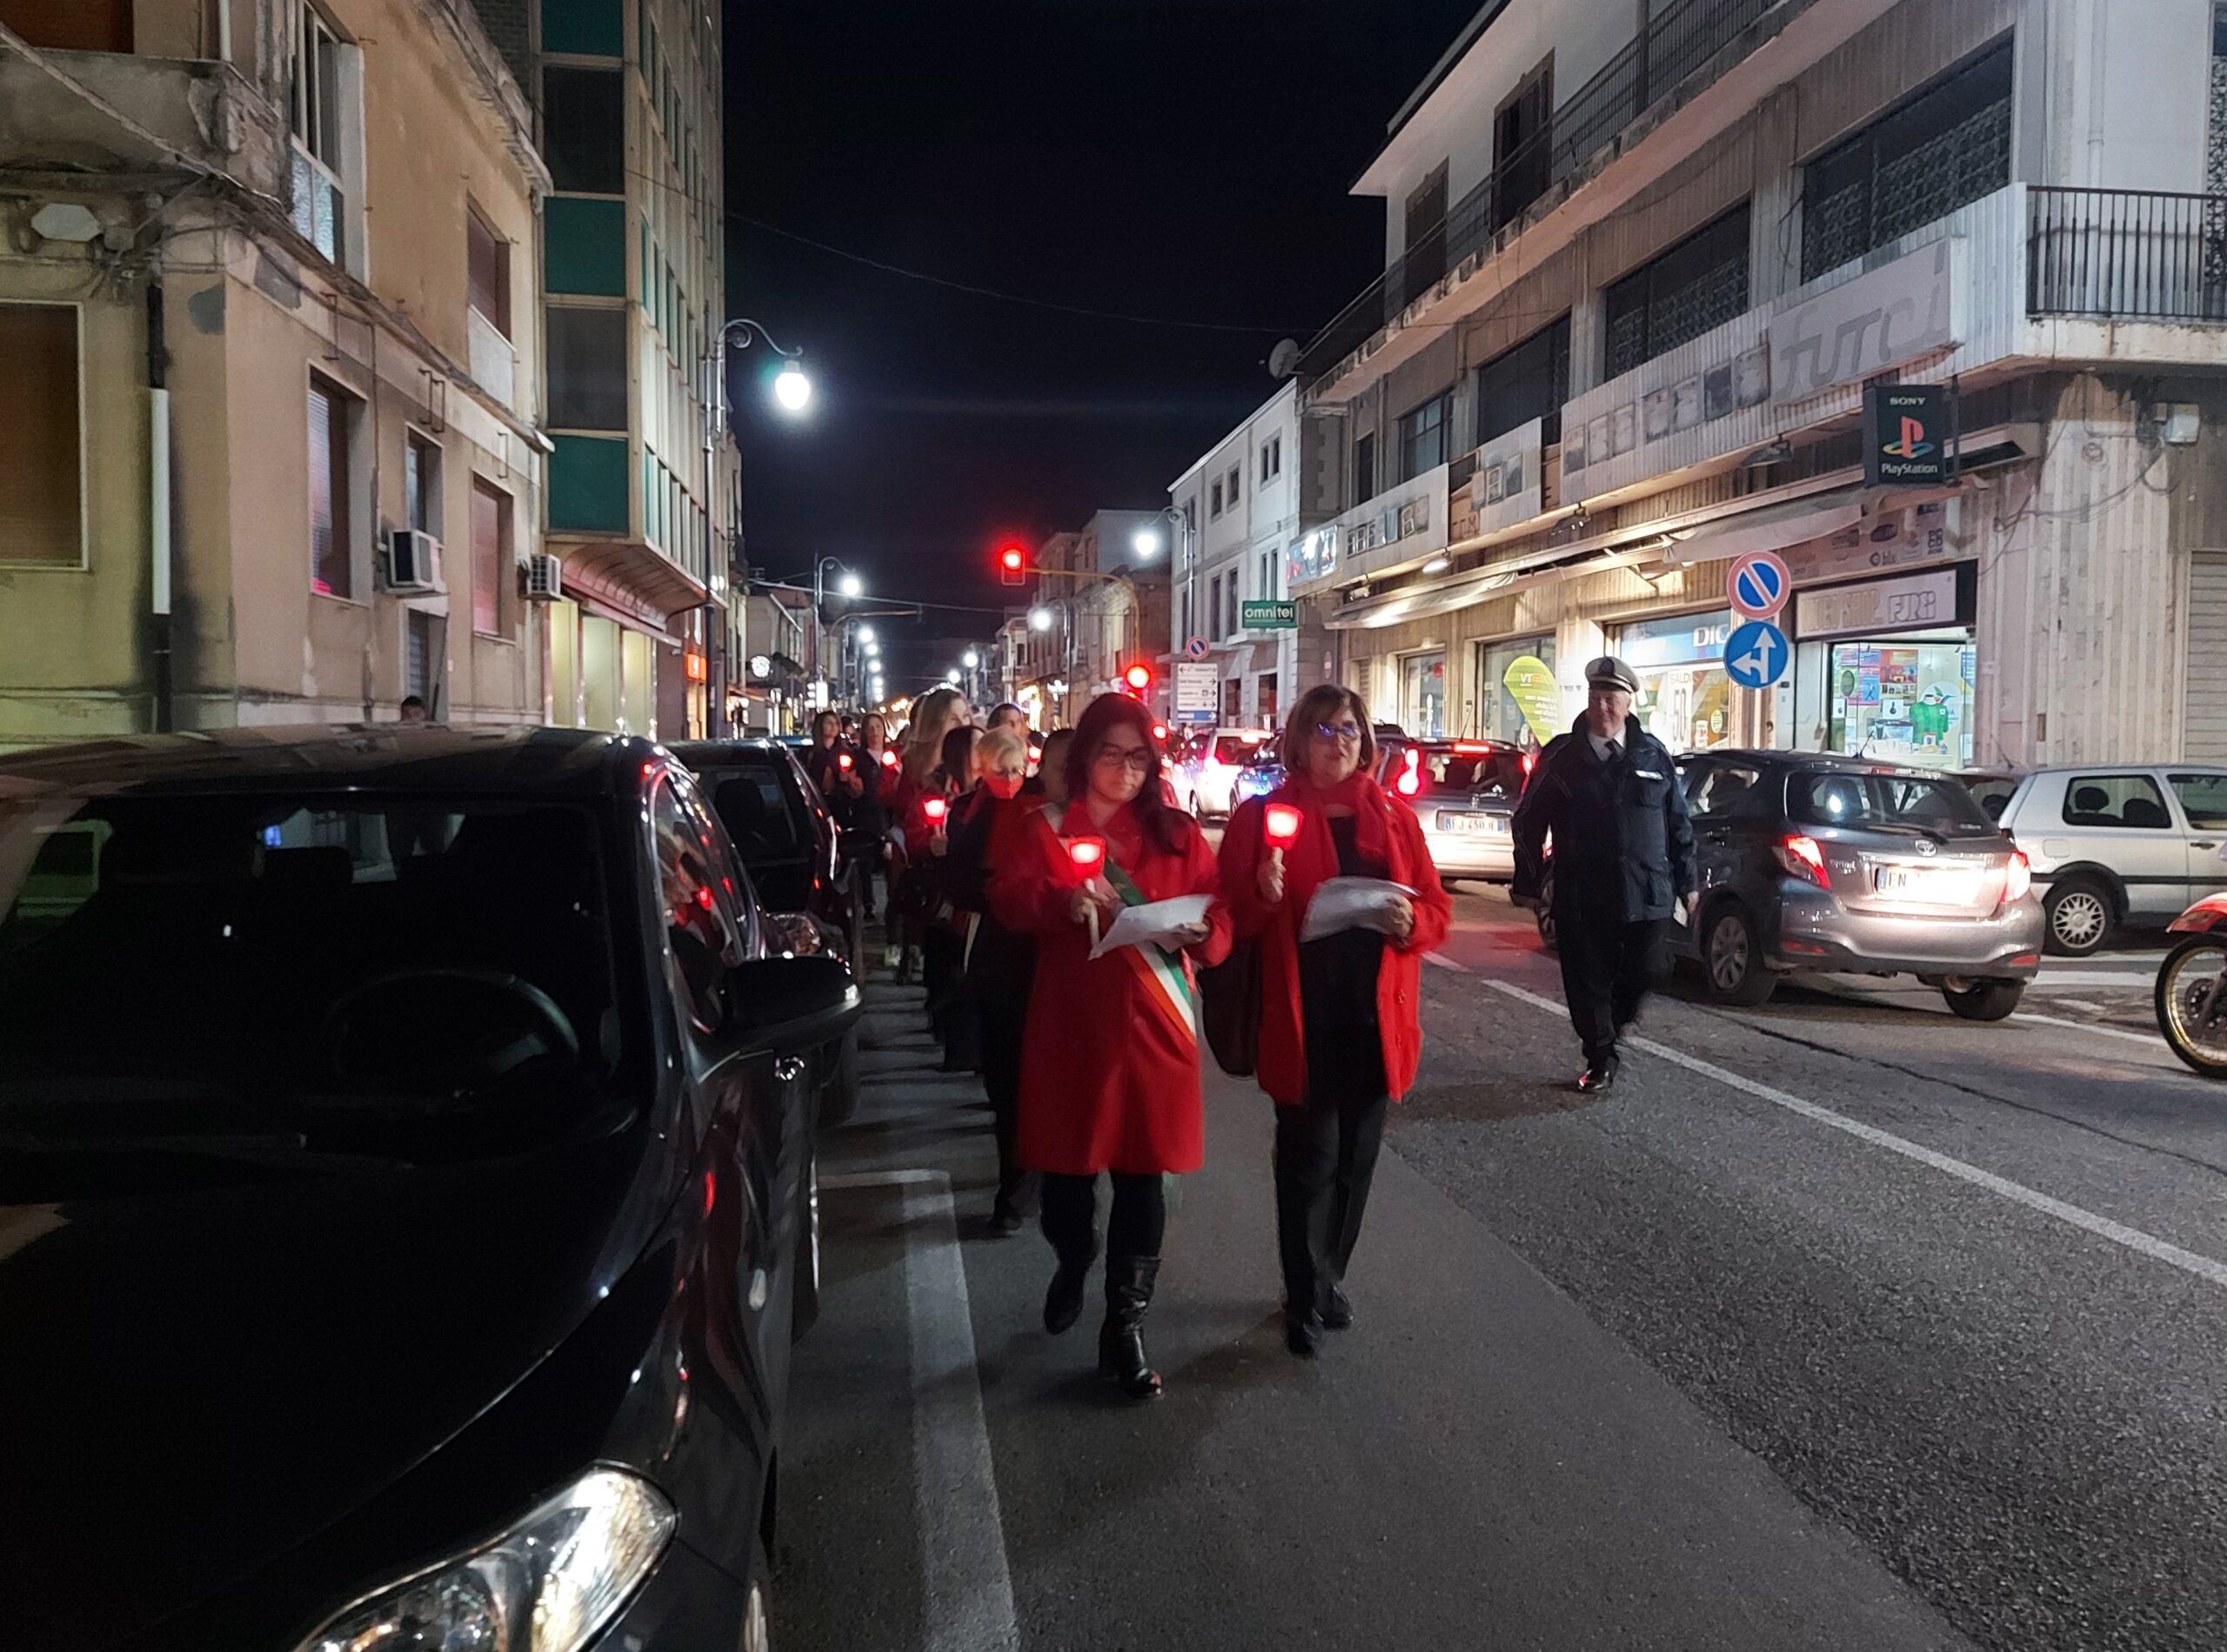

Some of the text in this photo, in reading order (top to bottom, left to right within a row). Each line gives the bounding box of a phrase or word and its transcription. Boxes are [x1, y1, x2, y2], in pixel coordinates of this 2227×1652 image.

[1889, 397, 1926, 406] SONY
[1881, 462, 1938, 477] PlayStation
[1244, 605, 1294, 619] omnitel
